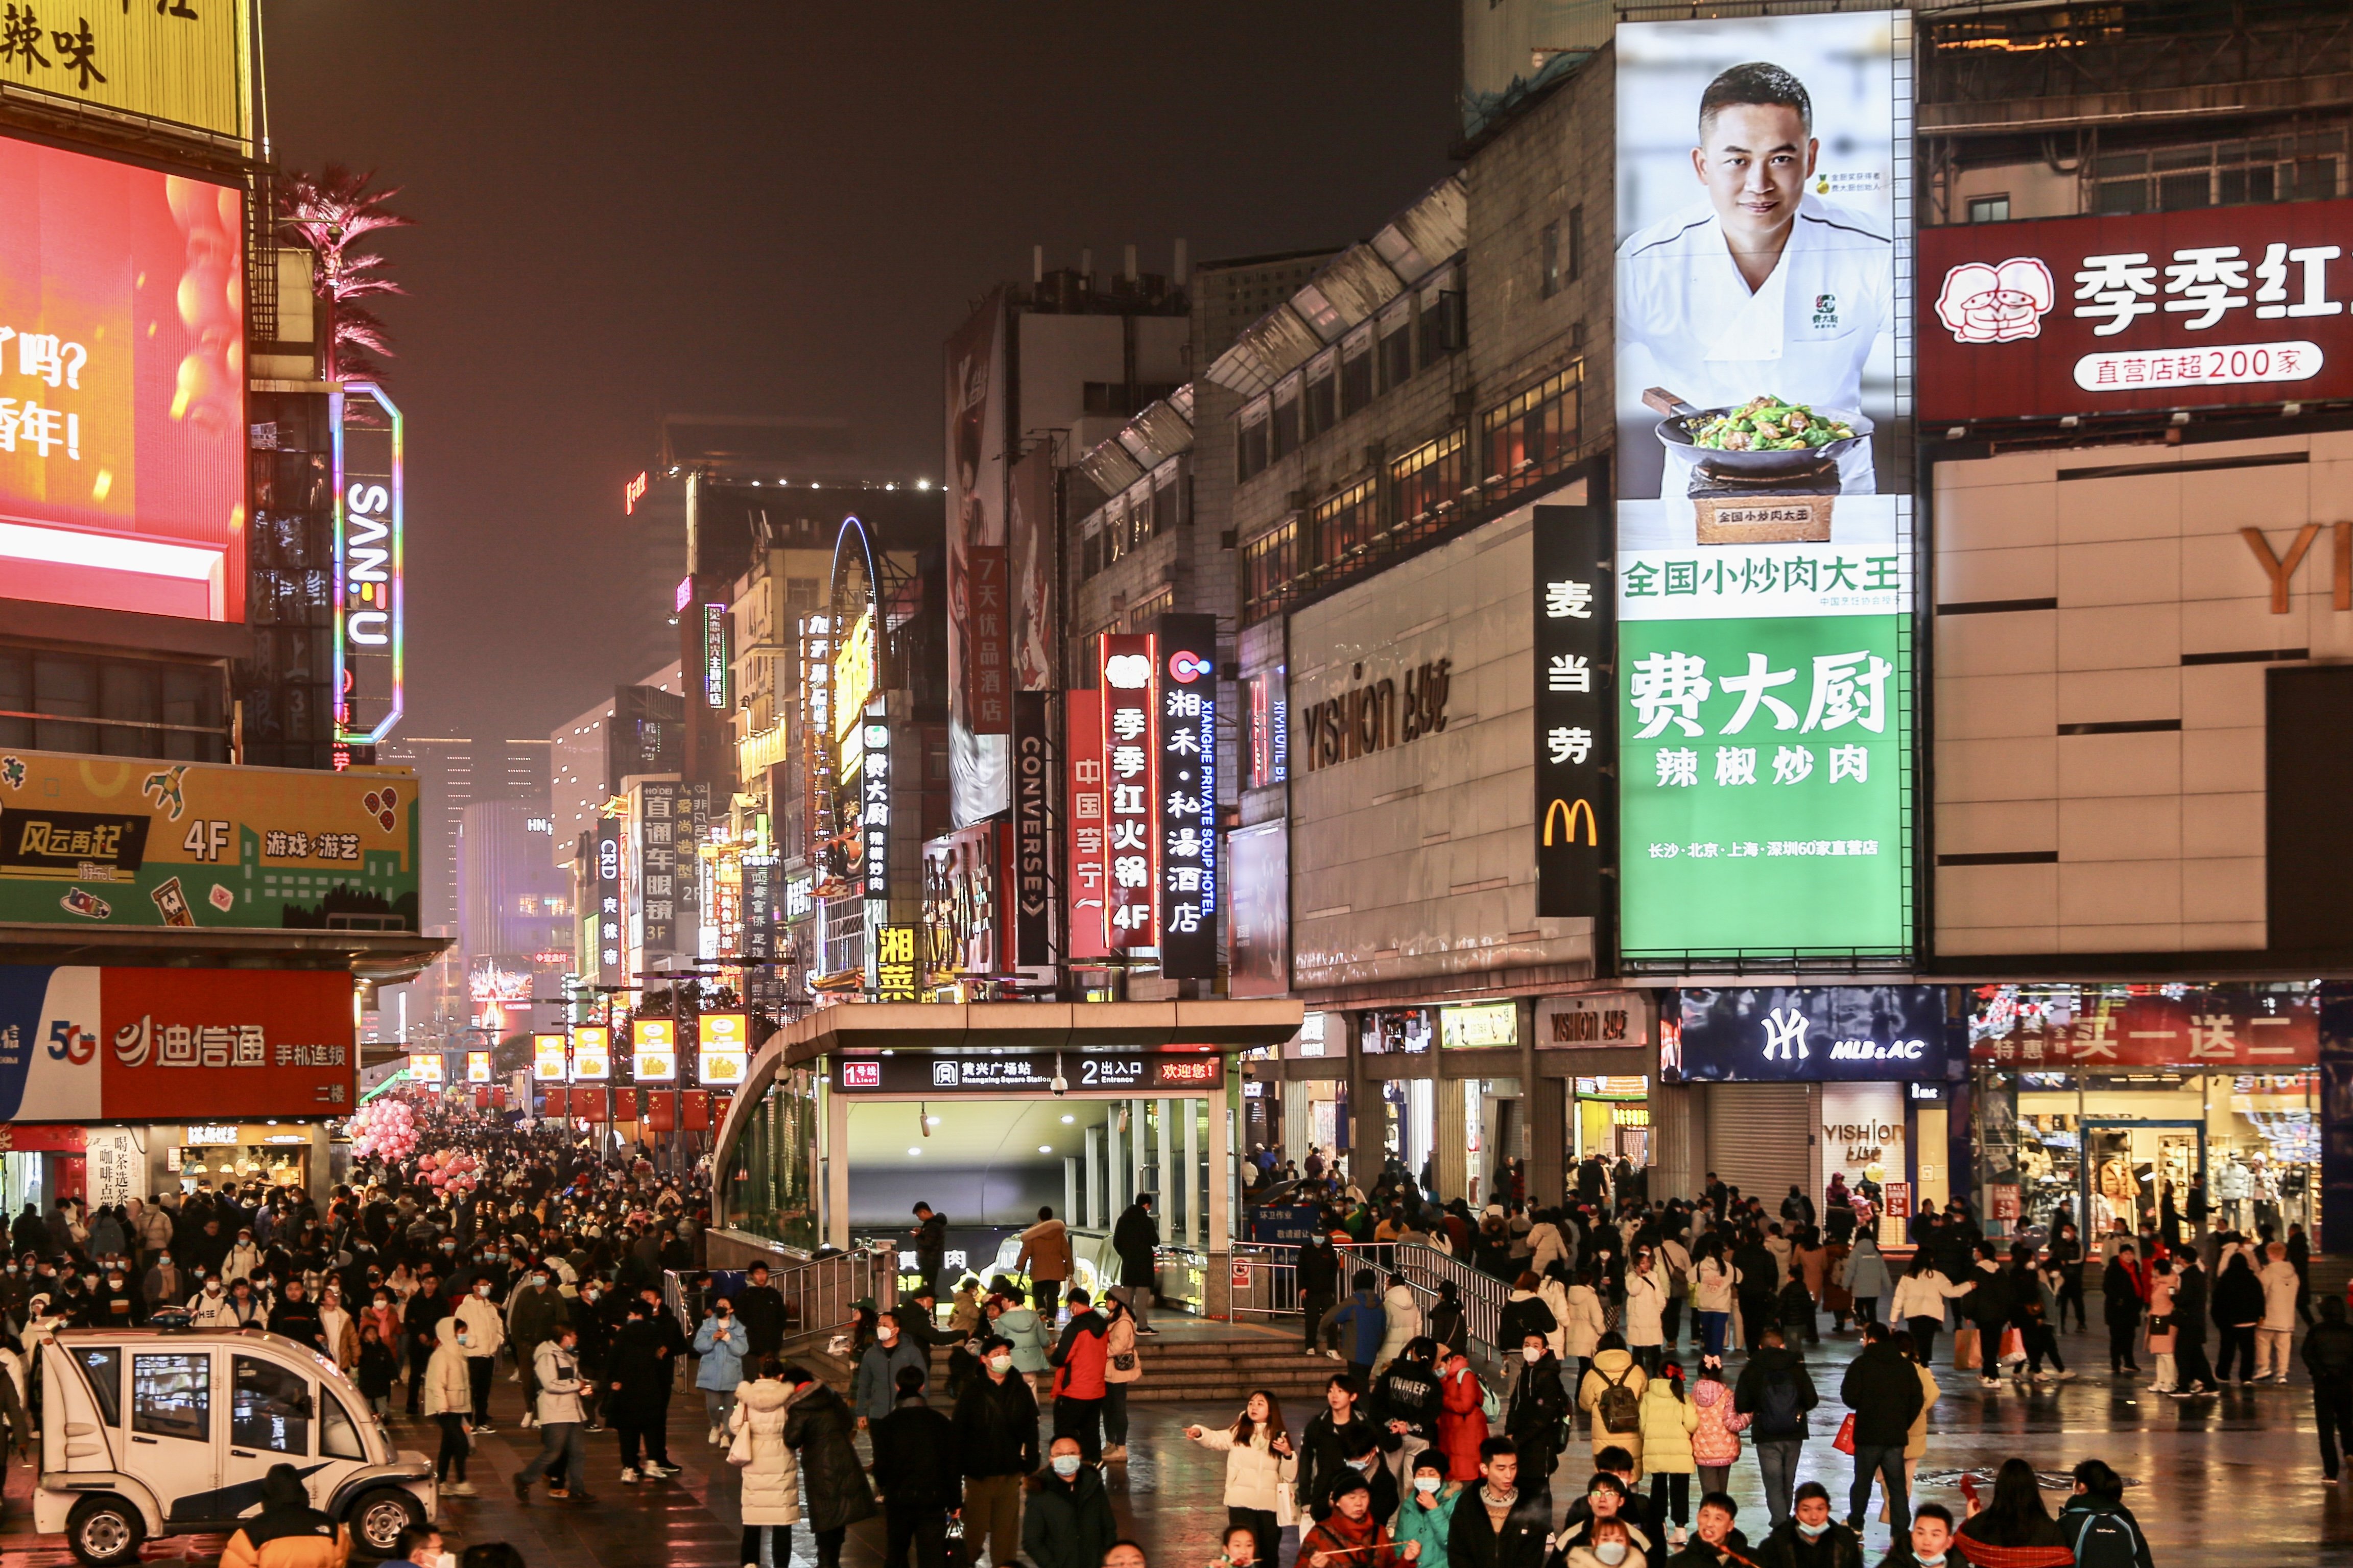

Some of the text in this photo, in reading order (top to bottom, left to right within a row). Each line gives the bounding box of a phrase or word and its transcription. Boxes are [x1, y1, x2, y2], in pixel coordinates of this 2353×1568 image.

[0, 4, 106, 90] 辣味
[2096, 349, 2301, 384] 直营店超200家
[1621, 555, 1902, 597] 全国小炒肉大王
[978, 558, 1002, 722] 7天优品酒店
[1546, 580, 1593, 765] 麦当劳
[1630, 649, 1893, 739] 费大厨
[1655, 743, 1869, 788] 辣椒炒肉
[864, 753, 889, 827] 费大厨
[1113, 708, 1147, 888] 季季红火锅
[1201, 701, 1215, 916] XIANGHE PRIVATE SOUP HOTEL
[1021, 736, 1042, 890] CONVERSE
[1075, 759, 1102, 888] 中国李宁
[18, 821, 123, 859] 风云再起
[183, 819, 229, 861] 4F
[266, 830, 359, 860] 游戏 游艺
[601, 839, 617, 880] CRD
[645, 796, 674, 920] 直通车眼镜
[677, 799, 694, 879] 爱尚造型
[647, 926, 666, 940] 3F
[1112, 904, 1150, 930] 4F
[878, 927, 915, 1001] 湘菜
[47, 1020, 96, 1066] 5G
[156, 1025, 266, 1067] 迪信通
[276, 1045, 346, 1067] 手机连锁
[2072, 1014, 2295, 1059] 买一送二
[961, 1062, 1031, 1076] 黄兴广场站
[962, 1076, 1000, 1084] Huangxing
[1001, 1076, 1026, 1084] Square
[1081, 1060, 1098, 1084] 2
[1101, 1060, 1142, 1076] 出入口
[316, 1084, 345, 1103] 二楼
[1259, 1211, 1293, 1220] 环卫作业
[1277, 1229, 1310, 1239] 敬请避让
